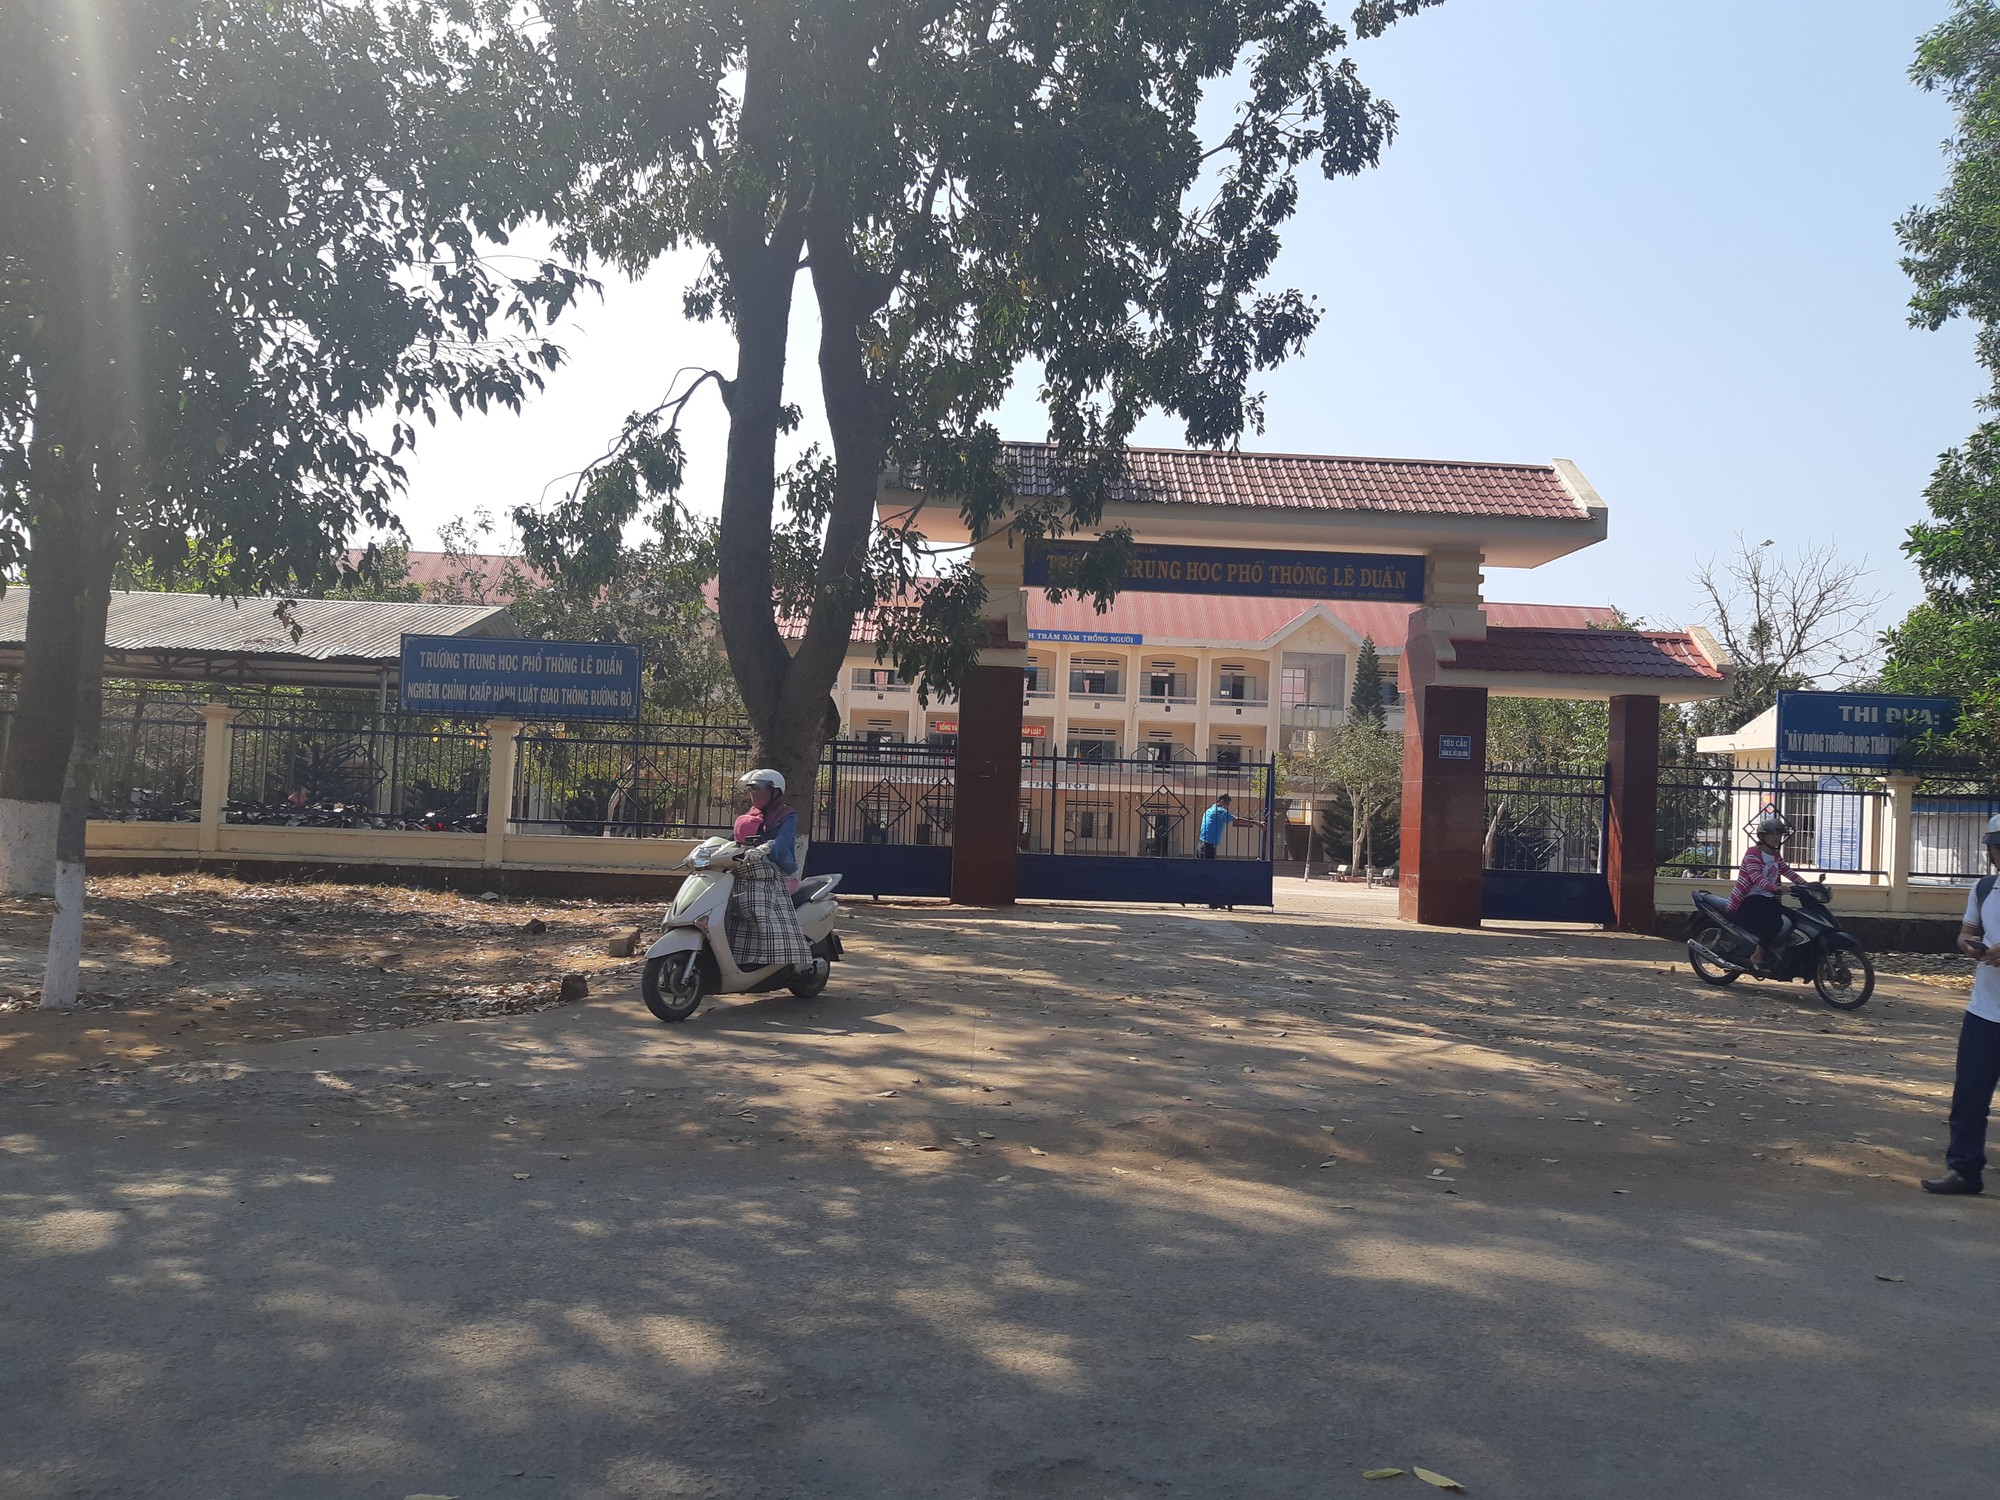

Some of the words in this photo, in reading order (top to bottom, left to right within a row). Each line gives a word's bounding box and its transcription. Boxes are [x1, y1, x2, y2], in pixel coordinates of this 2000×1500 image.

[1186, 561, 1222, 584] HỌC
[1226, 559, 1263, 583] PHỔ
[1268, 561, 1328, 586] THÔNG
[1332, 564, 1356, 587] LÊ
[1359, 565, 1407, 589] DUẨN
[1110, 634, 1134, 644] NGƯỜI
[420, 647, 460, 669] TRƯỜNG
[462, 653, 495, 670] TRUNG
[499, 654, 518, 673] HỌC
[522, 648, 544, 672] PHỔ
[545, 653, 577, 674] THÔNG
[581, 654, 592, 674] LÊ
[596, 650, 623, 675] DUẨN
[407, 680, 439, 699] NGHIÊM
[441, 678, 467, 700] CHỈNH
[469, 680, 491, 701] CHẤP
[493, 682, 516, 701] HÀNH
[518, 683, 539, 706] LUẬT
[540, 687, 559, 703] GIAO
[561, 685, 588, 705] THÔNG
[590, 685, 618, 706] ĐƯỜNG
[620, 687, 632, 710] BỘ
[1838, 705, 1878, 723] THI
[1854, 735, 1869, 757] HỌC
